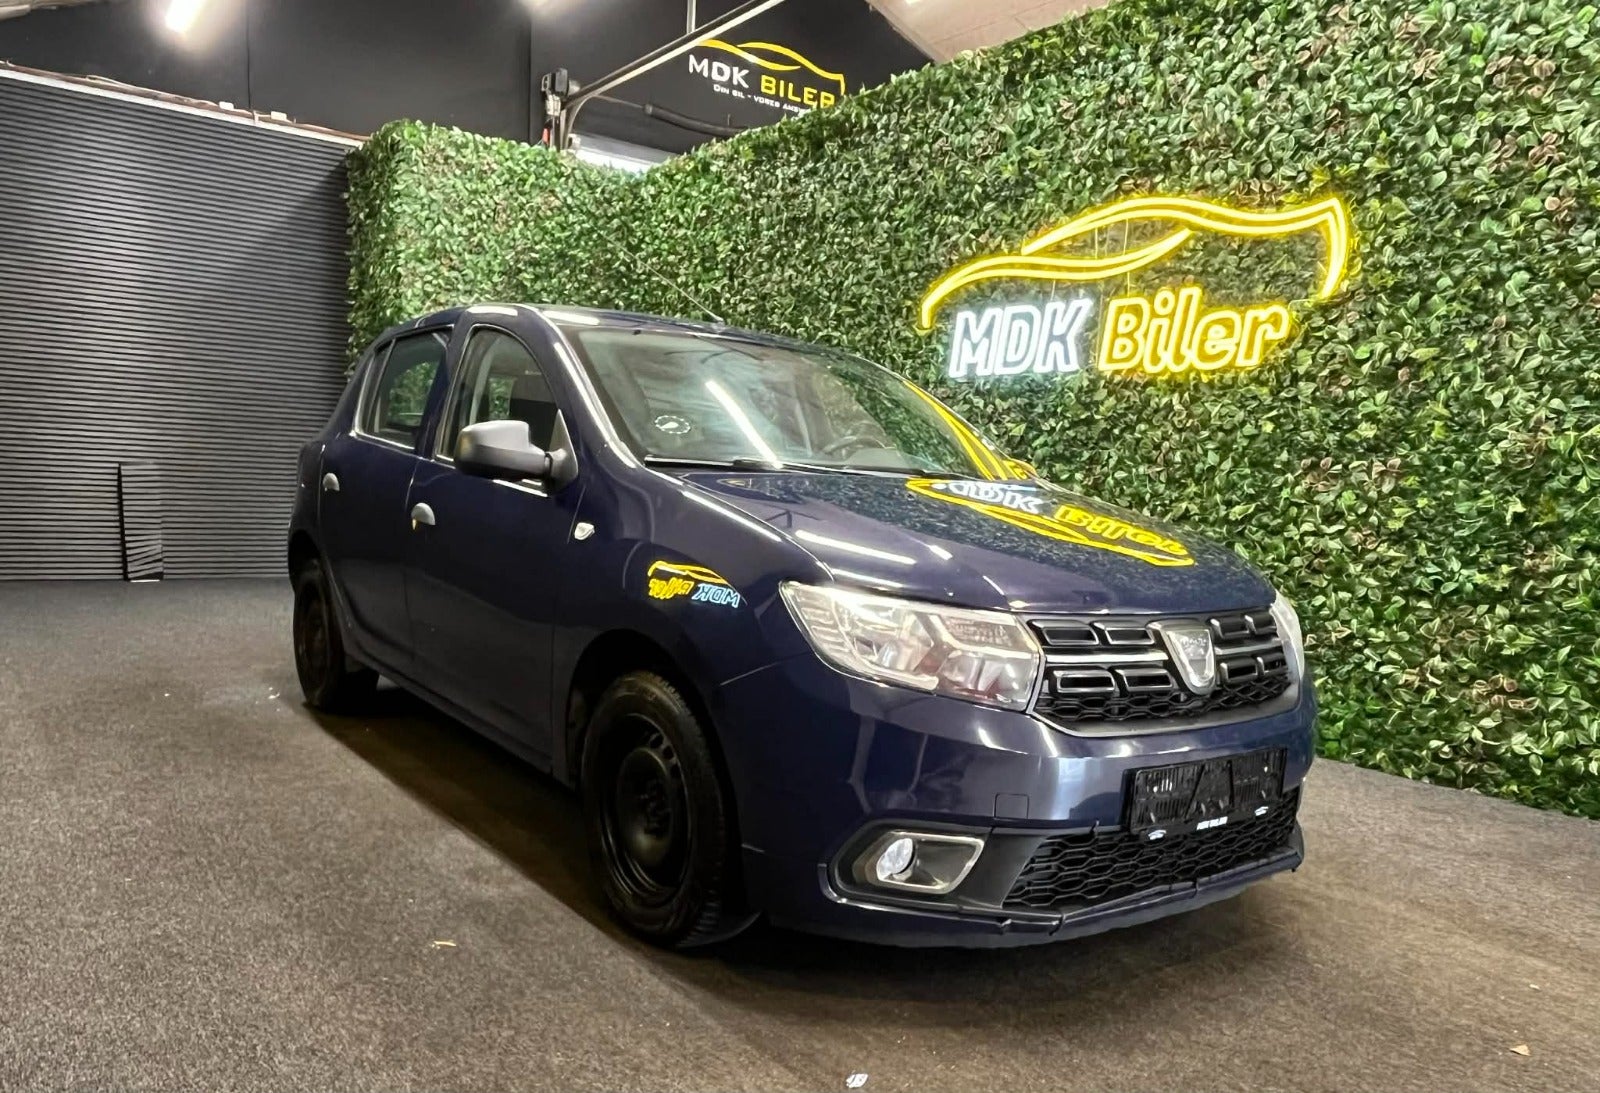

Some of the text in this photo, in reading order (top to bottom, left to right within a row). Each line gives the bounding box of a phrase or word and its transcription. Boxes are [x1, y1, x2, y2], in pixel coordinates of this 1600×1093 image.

[688, 54, 835, 109] MDK BILER
[949, 286, 1290, 378] MDK Biler
